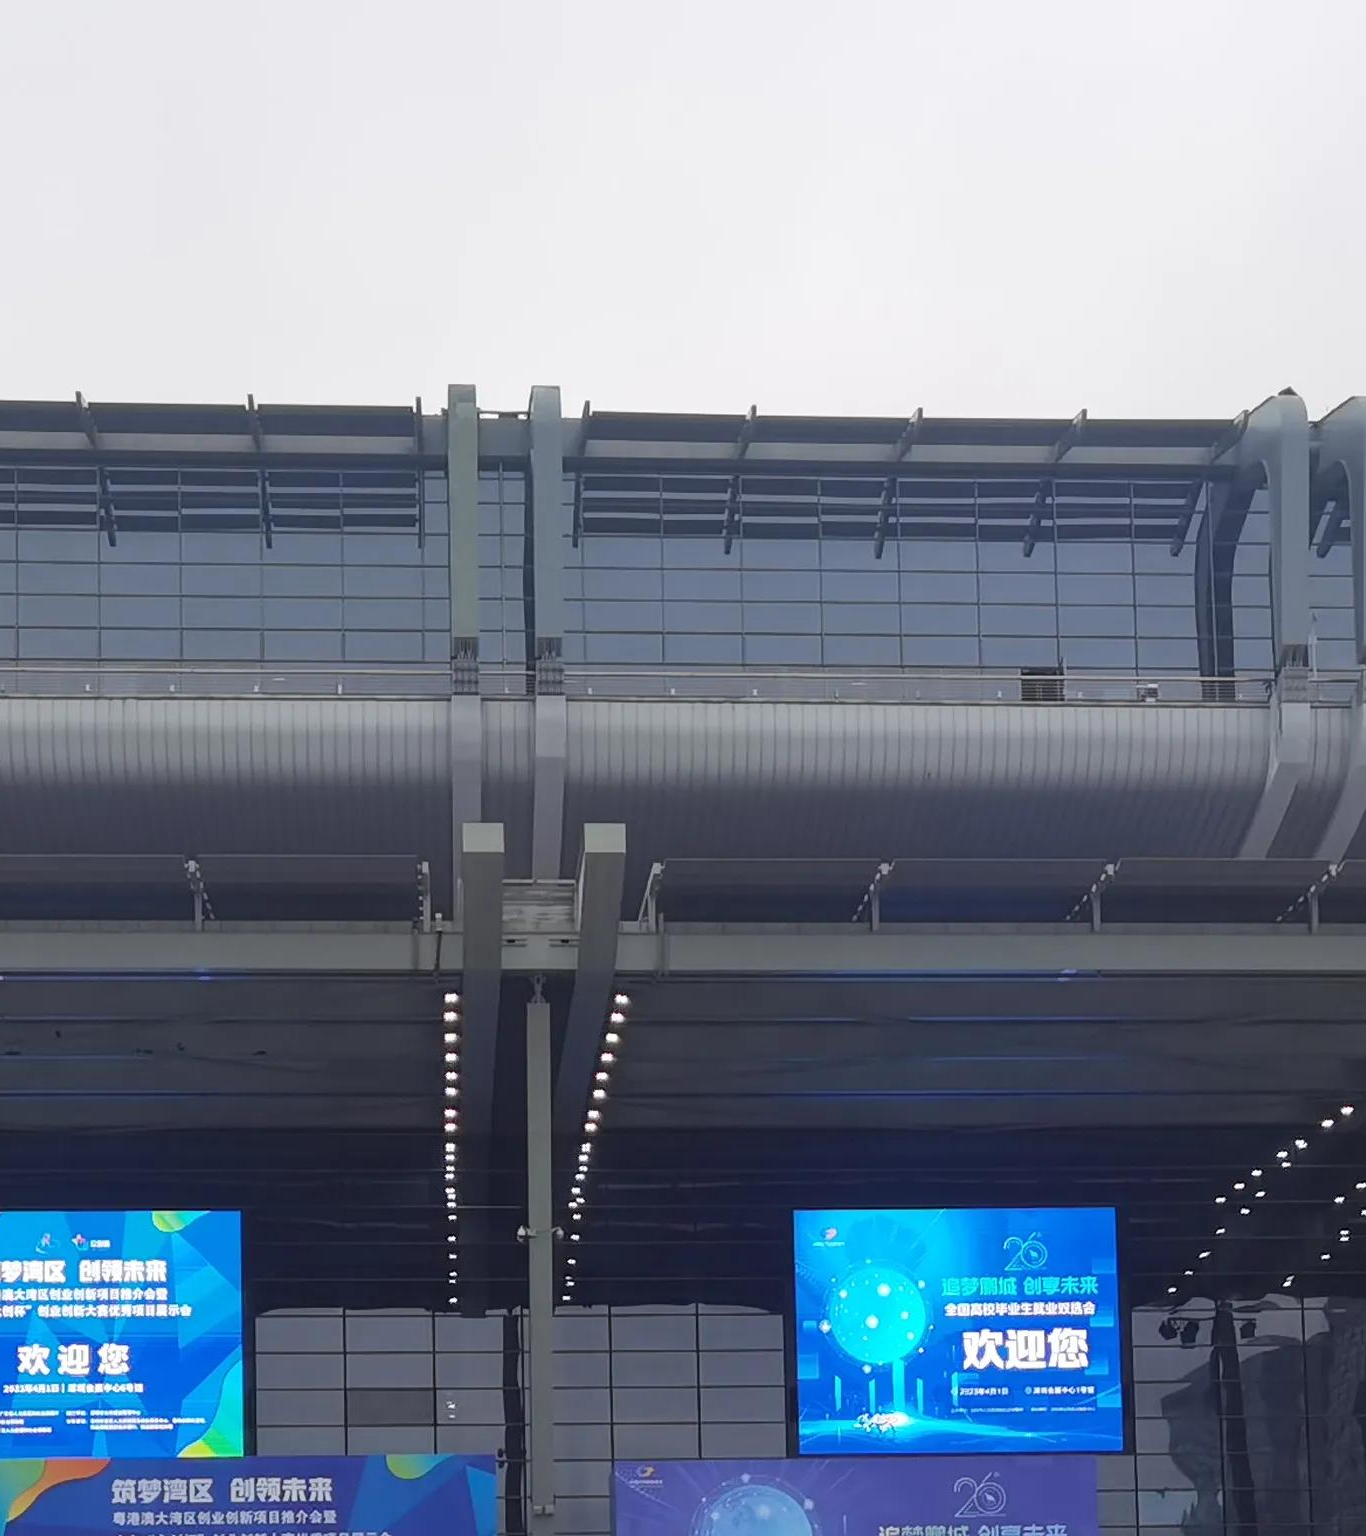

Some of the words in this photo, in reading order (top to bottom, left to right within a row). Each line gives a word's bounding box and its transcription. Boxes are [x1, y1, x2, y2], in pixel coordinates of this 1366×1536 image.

[1023, 1276, 1099, 1295] 创享未来
[17, 1343, 130, 1376] 欢迎您
[962, 1329, 1089, 1370] 欢迎您
[111, 1478, 214, 1504] 筑梦湾区
[230, 1477, 333, 1503] 创领未来
